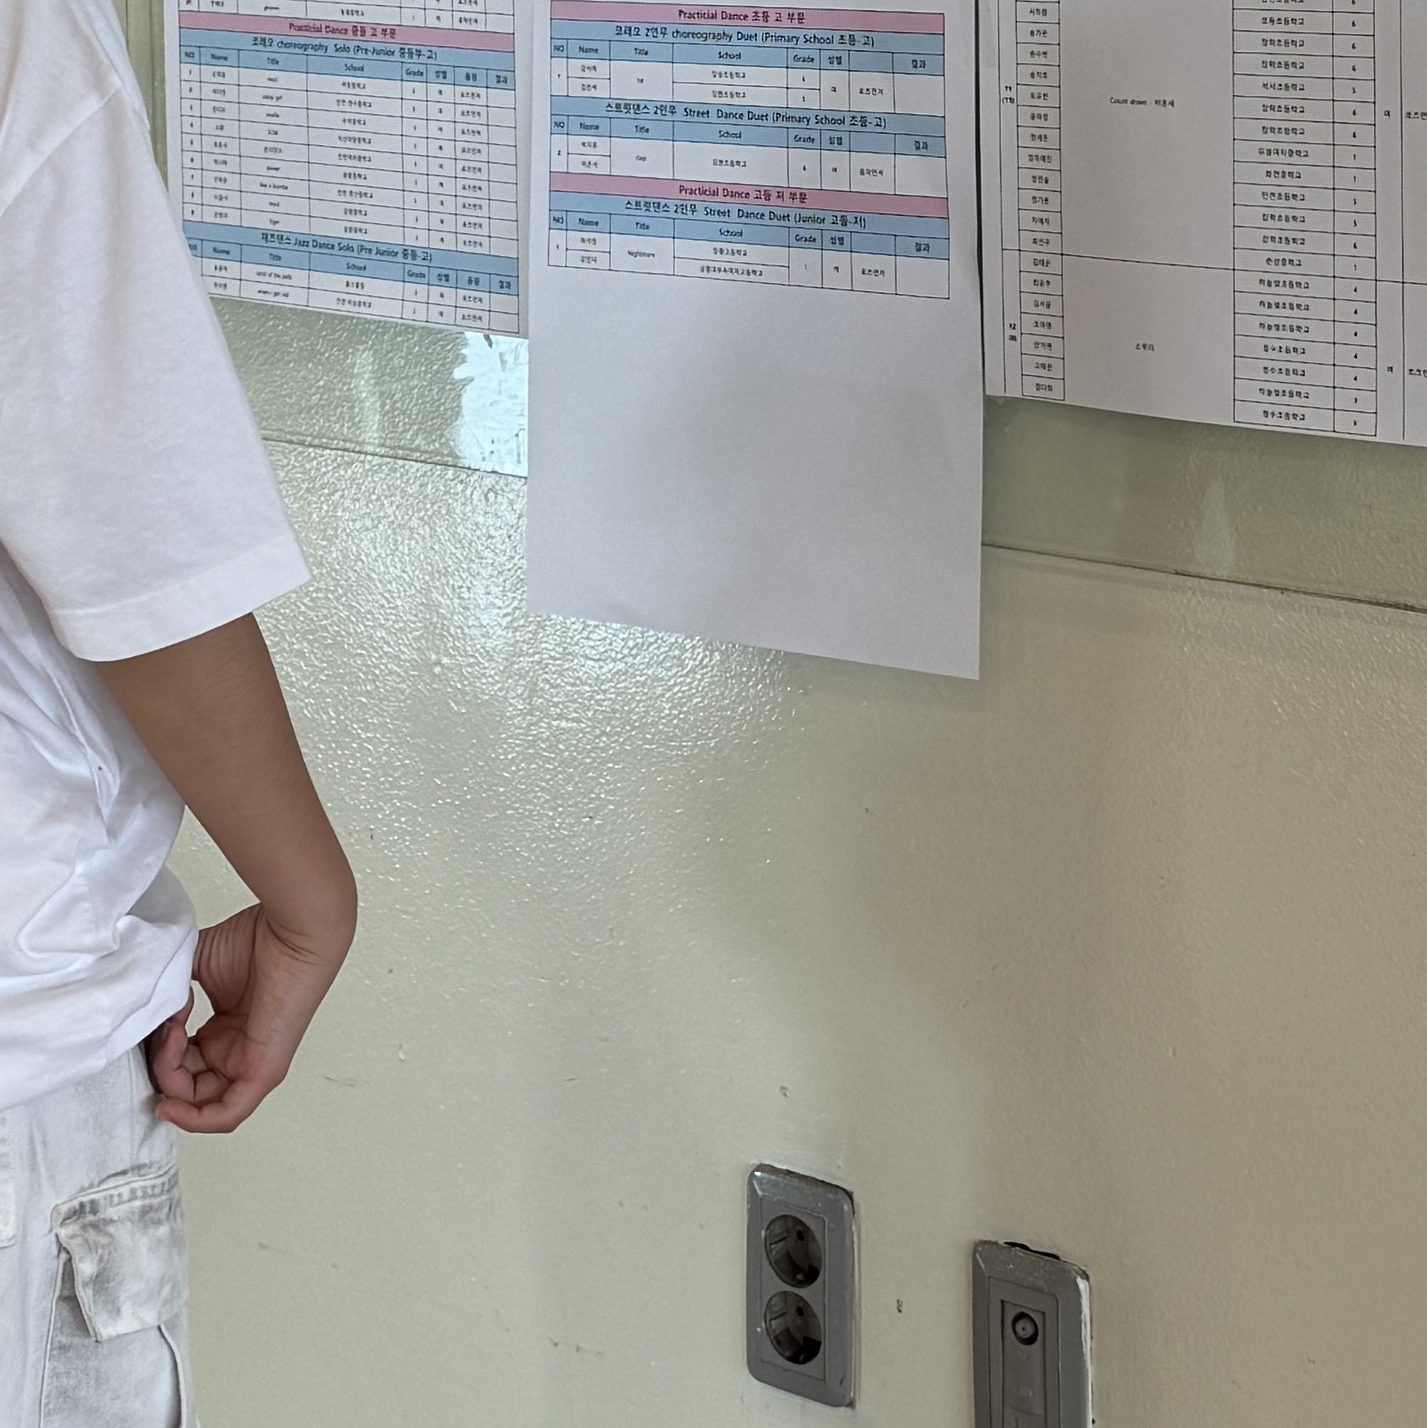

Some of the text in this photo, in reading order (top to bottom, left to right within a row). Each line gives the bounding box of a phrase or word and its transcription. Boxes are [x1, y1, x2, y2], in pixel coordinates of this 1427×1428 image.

[678, 9, 717, 20] Practicial
[720, 10, 750, 21] Dance
[774, 11, 784, 22] 고
[787, 12, 806, 24] 부문
[672, 28, 733, 44] choreography
[736, 31, 758, 42] Duet
[761, 32, 801, 46] (Primary
[804, 34, 834, 44] School
[683, 106, 710, 118] Street
[716, 109, 744, 119] Dance
[747, 110, 769, 121] Duet
[772, 111, 812, 126] (Primary
[815, 114, 846, 125] School
[679, 184, 719, 197] Practicial
[722, 188, 750, 199] Dance
[788, 192, 808, 204] 부문
[703, 206, 731, 217] Street
[737, 208, 766, 220] Dance
[768, 211, 791, 222] Duet
[794, 212, 826, 226] (Junior
[293, 238, 310, 248] Jazz
[312, 240, 336, 252] Dance
[338, 243, 354, 252] Solo
[375, 248, 399, 258] Junior
